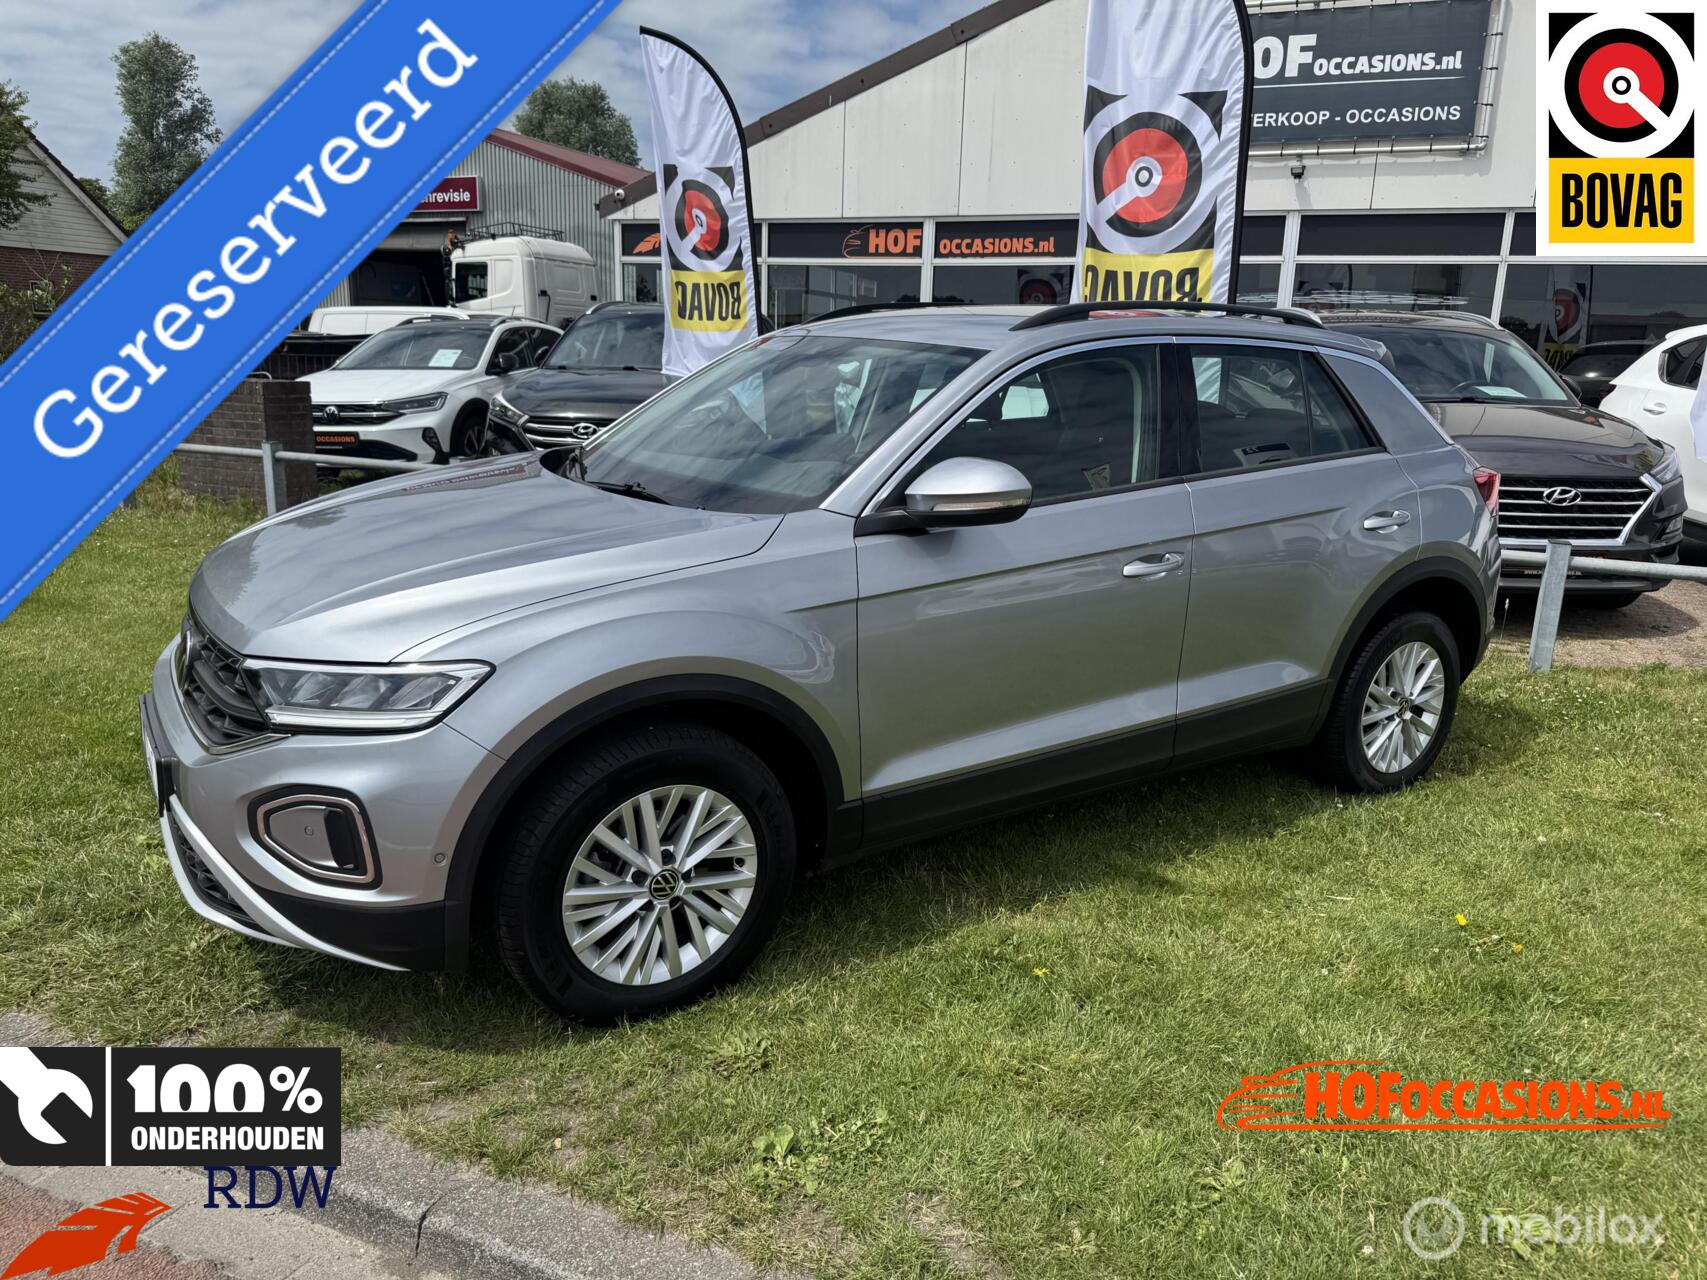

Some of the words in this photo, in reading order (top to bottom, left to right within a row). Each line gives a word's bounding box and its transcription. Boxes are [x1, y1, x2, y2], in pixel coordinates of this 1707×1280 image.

[1253, 33, 1463, 79] OFOCCASIONS.nl
[1252, 110, 1330, 127] ERKOOP
[1345, 104, 1462, 124] OCCASIONS
[422, 188, 471, 203] nrevisie
[868, 228, 923, 254] HOF
[939, 236, 1055, 255] OCCASIONS.nl
